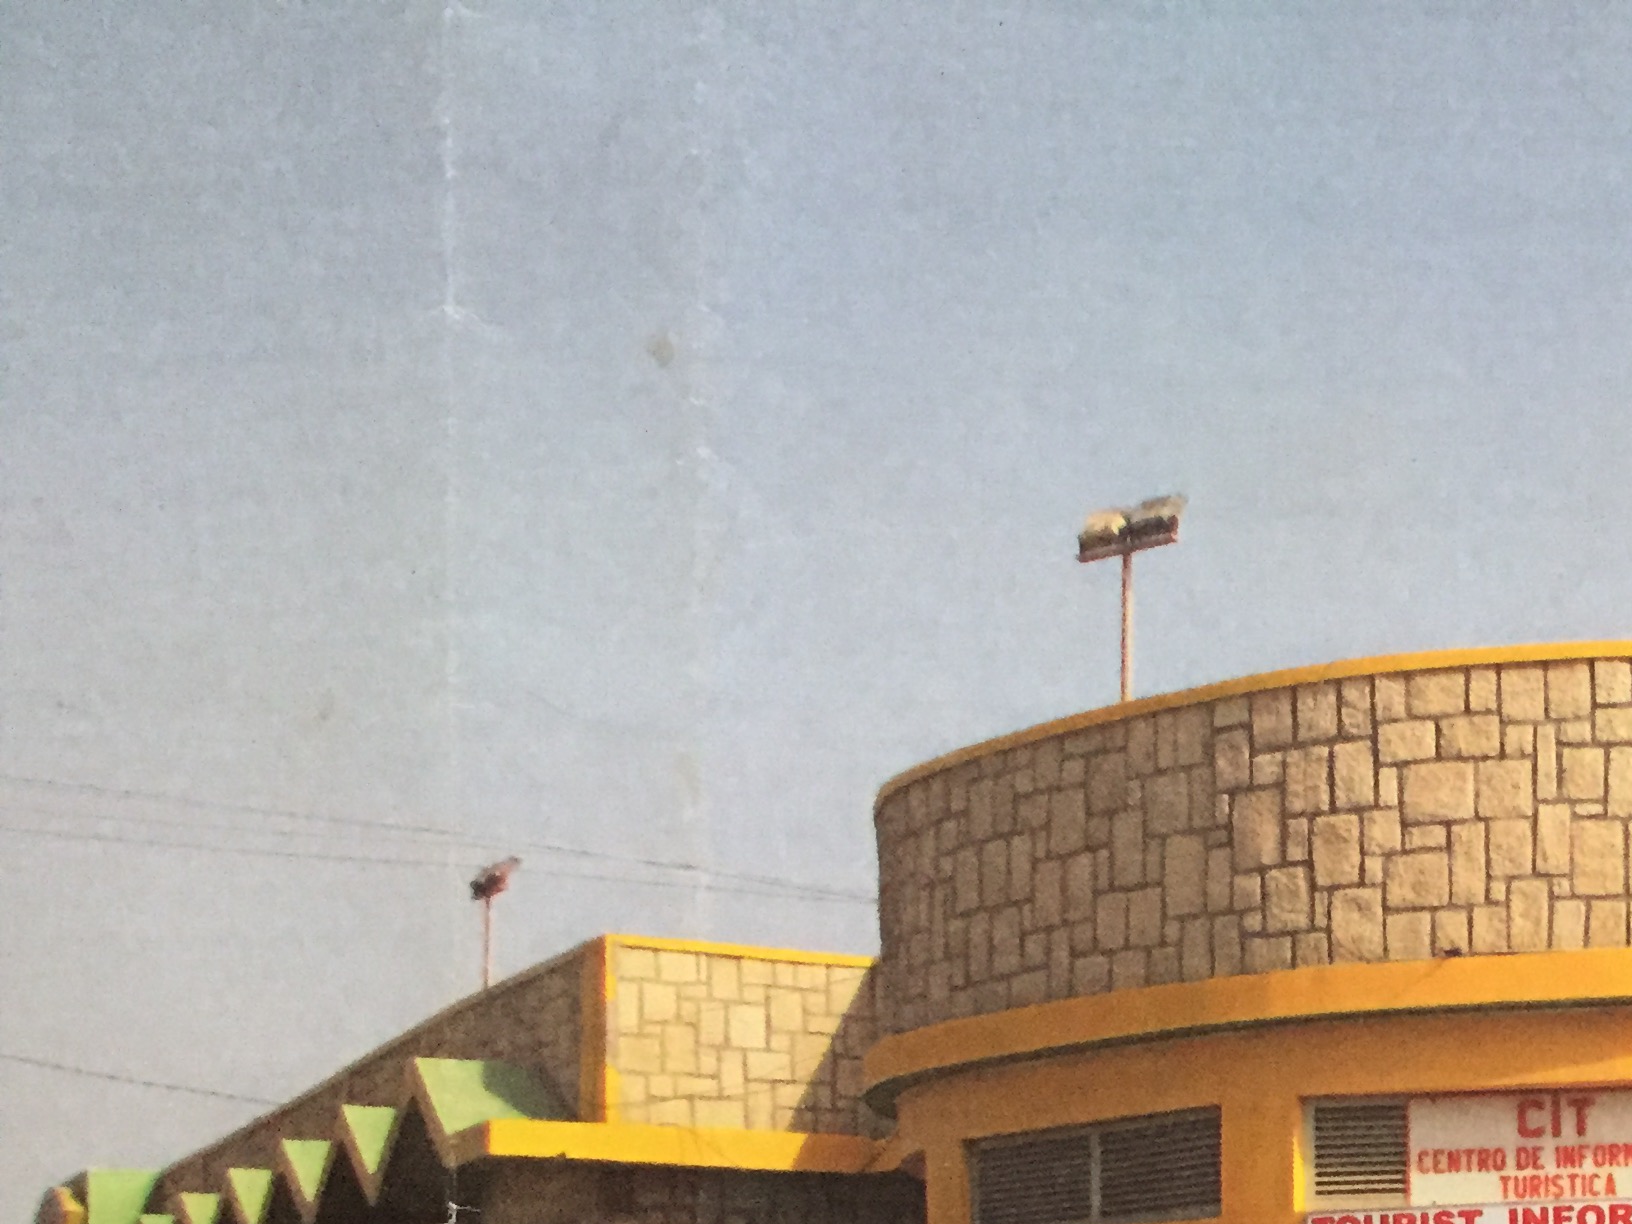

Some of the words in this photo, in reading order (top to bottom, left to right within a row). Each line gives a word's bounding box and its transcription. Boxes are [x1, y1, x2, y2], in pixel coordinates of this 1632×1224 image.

[1516, 1096, 1595, 1138] CIT
[1417, 1145, 1507, 1175] CENTRO
[1515, 1145, 1546, 1171] DE
[1500, 1172, 1617, 1199] TURISTICA
